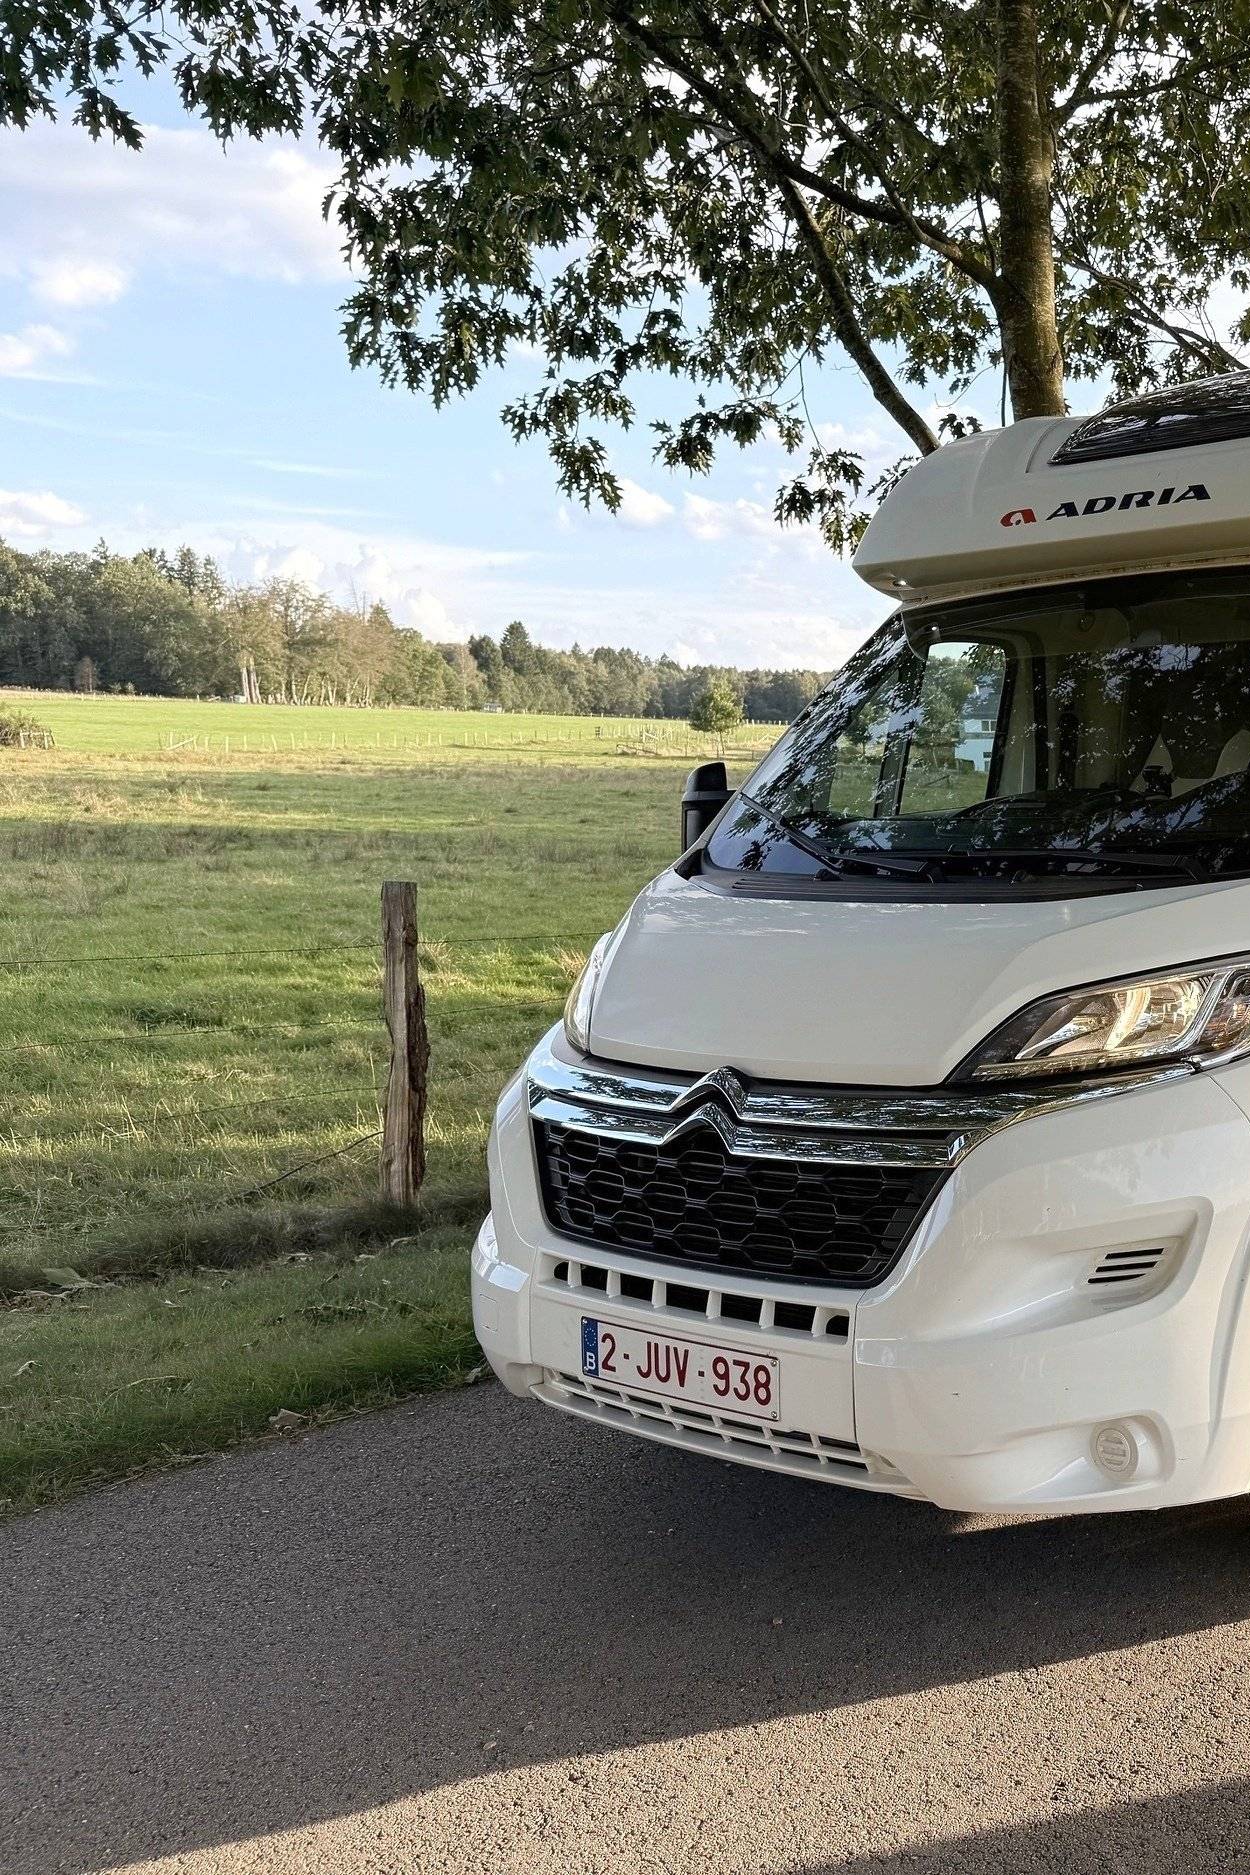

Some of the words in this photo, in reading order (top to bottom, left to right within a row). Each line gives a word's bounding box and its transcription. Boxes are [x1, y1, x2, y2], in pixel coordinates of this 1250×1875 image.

[1046, 484, 1211, 521] ADRIA
[586, 1352, 596, 1370] B
[601, 1333, 772, 1406] 2-JUV-938
